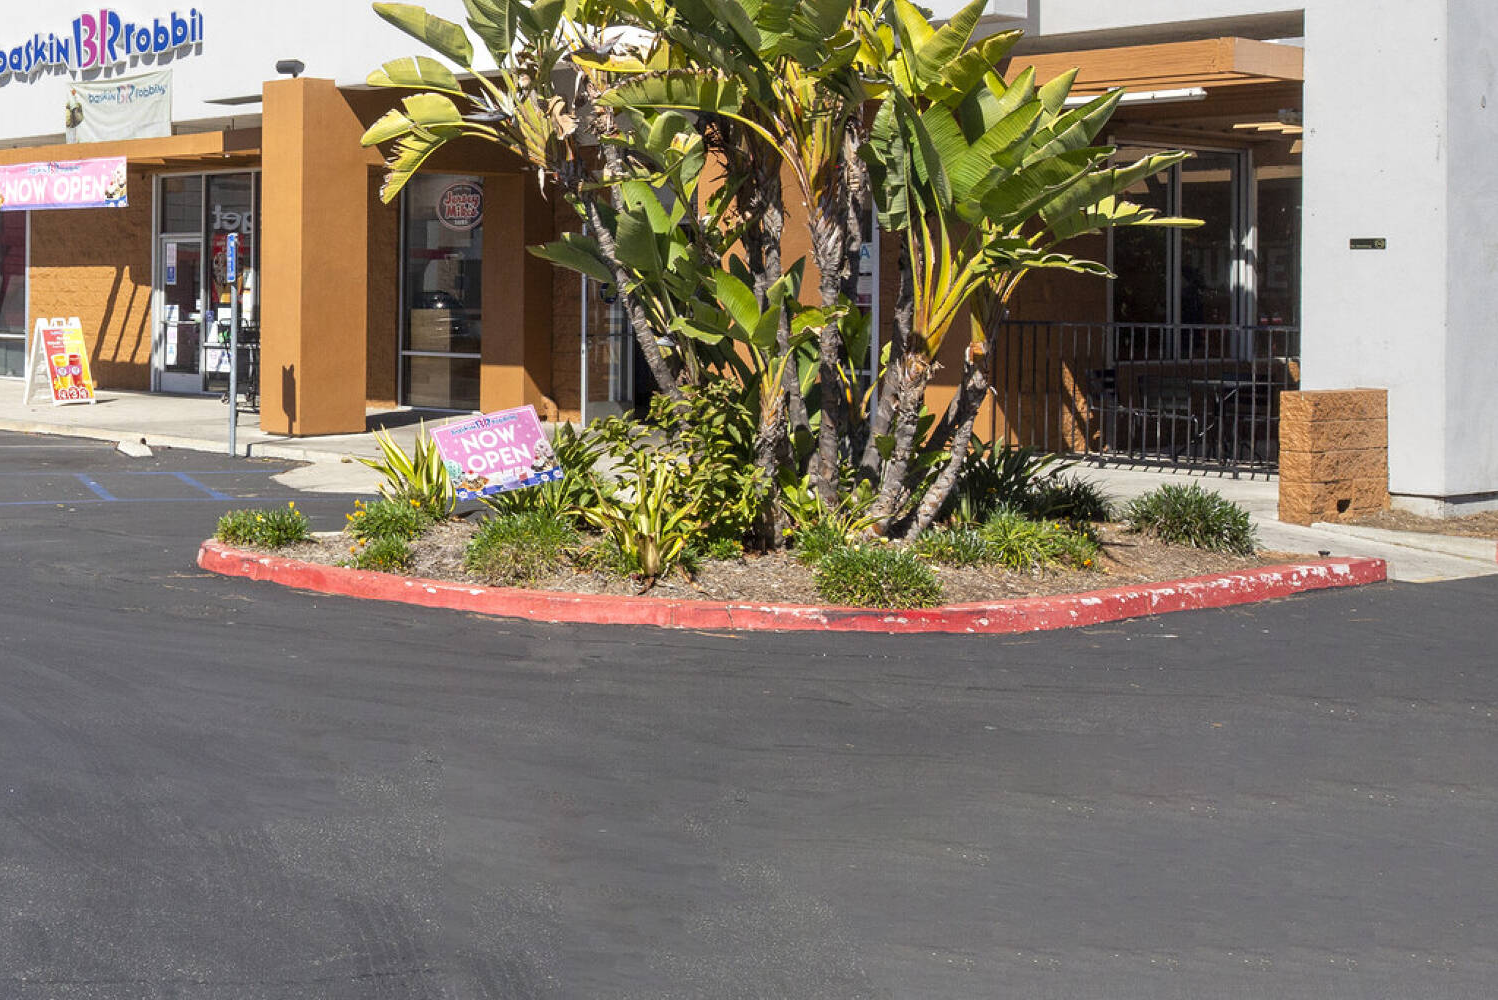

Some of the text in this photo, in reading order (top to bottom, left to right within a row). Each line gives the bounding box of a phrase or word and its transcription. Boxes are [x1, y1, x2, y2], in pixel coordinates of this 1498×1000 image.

[73, 9, 121, 68] BR
[6, 175, 106, 202] NOW OPEN
[461, 424, 515, 454] NOW
[467, 443, 532, 472] OPEN
